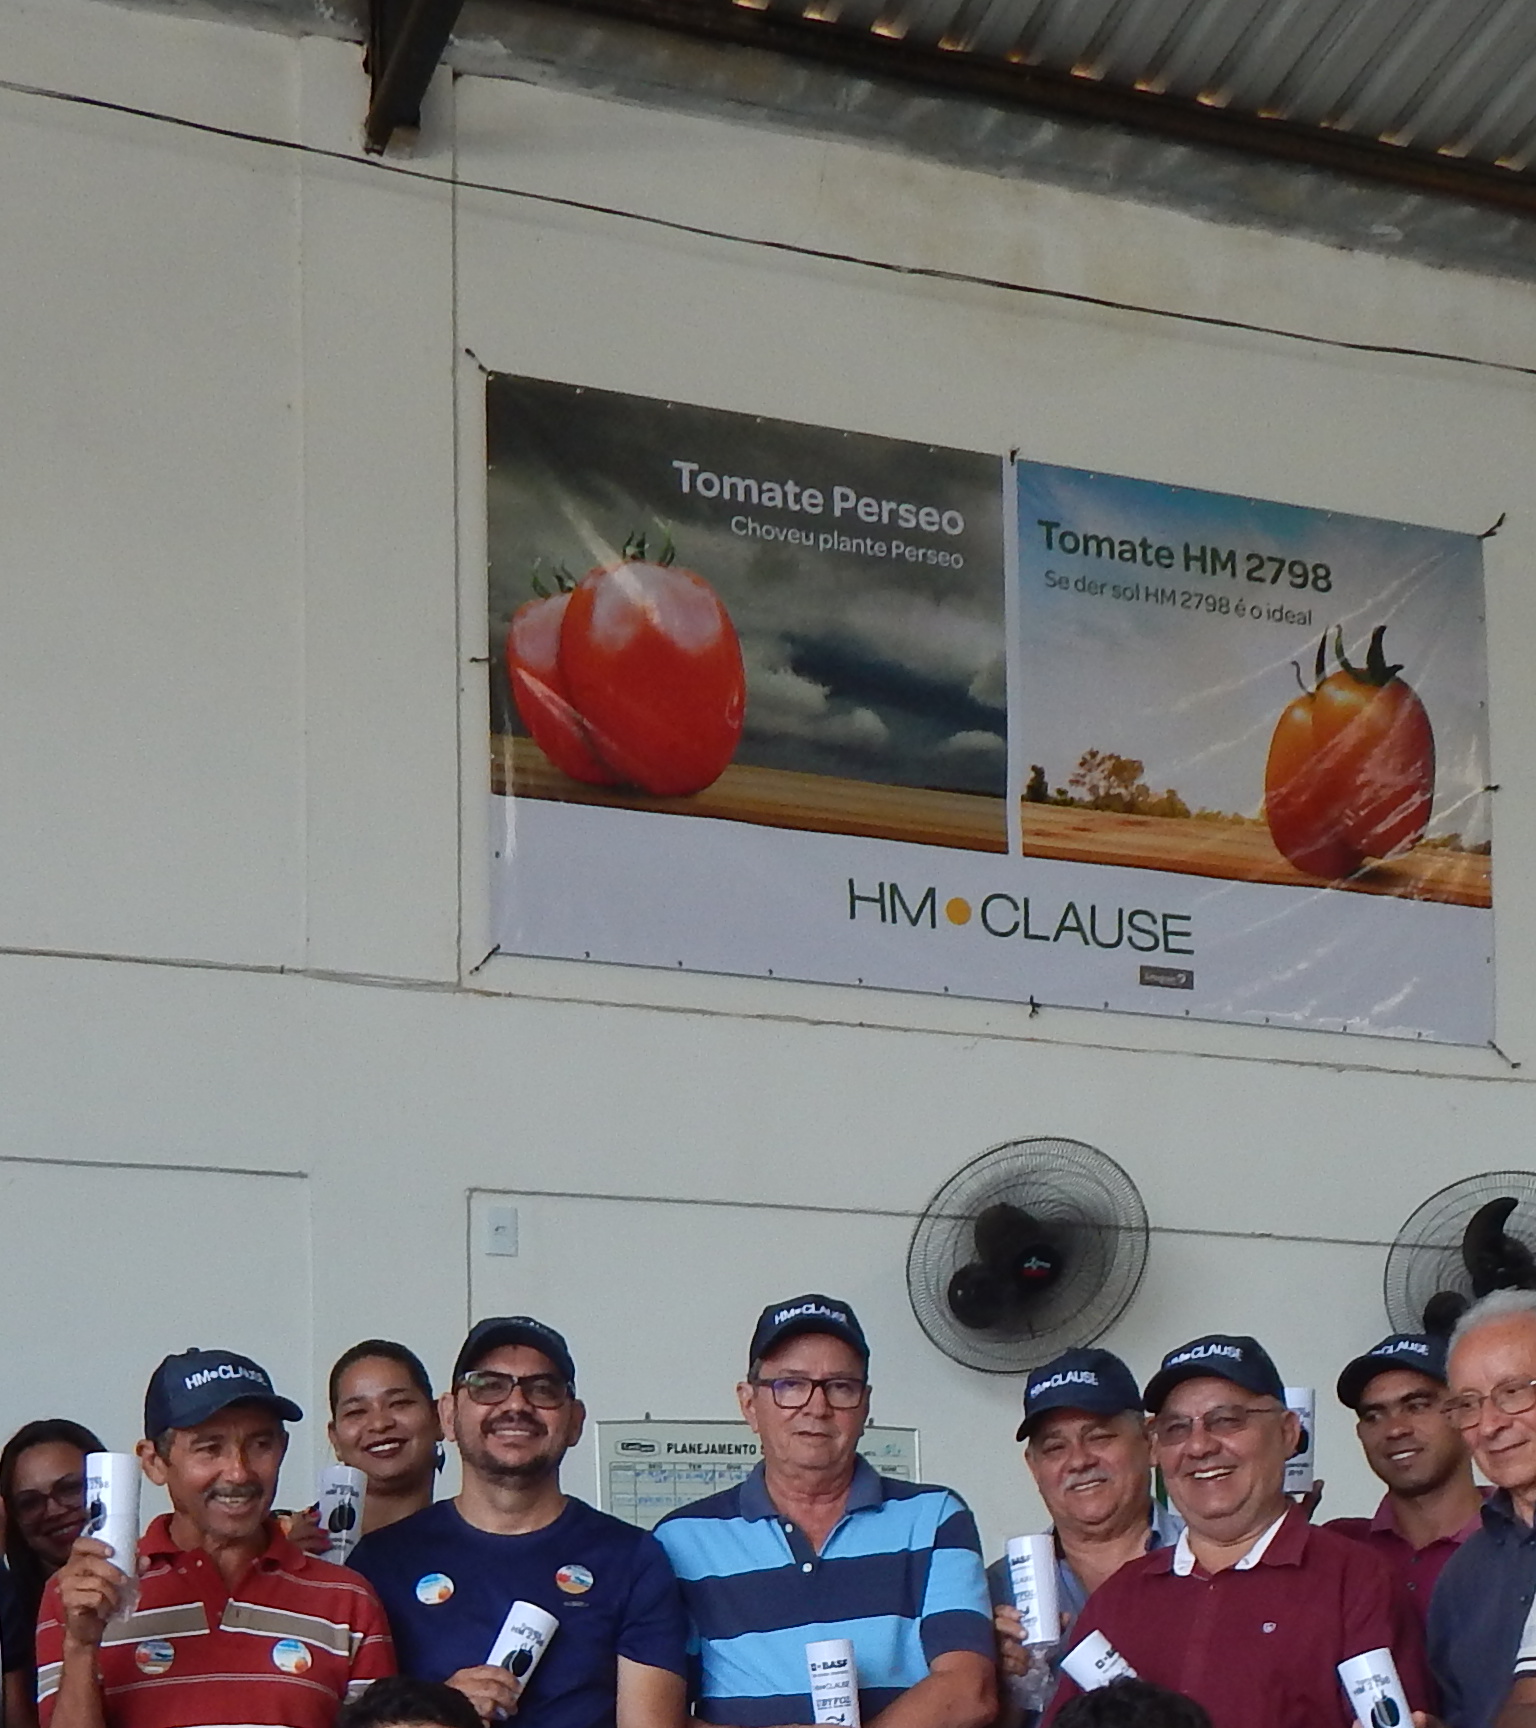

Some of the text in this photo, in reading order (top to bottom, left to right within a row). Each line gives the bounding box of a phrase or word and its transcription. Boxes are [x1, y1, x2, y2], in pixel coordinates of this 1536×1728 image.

[672, 459, 965, 535] Tomate Perseo
[730, 515, 964, 569] Choveu plante Perseo
[1037, 519, 1332, 593] Tomate HM 2798
[1044, 570, 1312, 627] Se der sol HM 2798 é o ideal
[667, 1442, 757, 1456] PLANEJAMENTO
